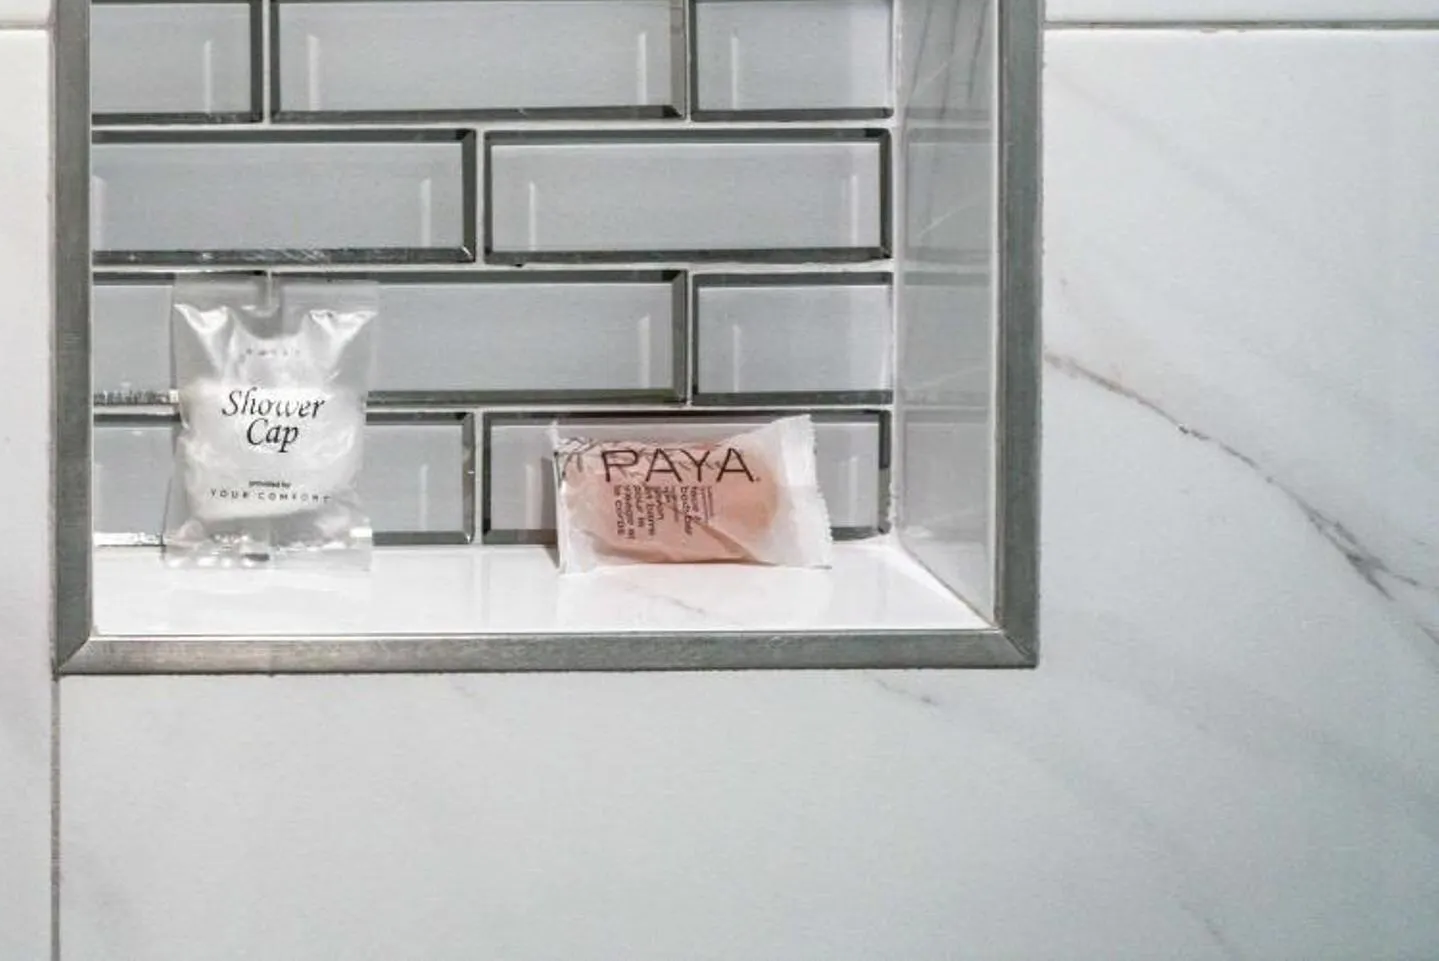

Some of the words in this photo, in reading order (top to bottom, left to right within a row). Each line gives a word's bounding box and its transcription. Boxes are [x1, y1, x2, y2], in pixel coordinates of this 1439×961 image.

[221, 386, 326, 420] Shower
[246, 417, 300, 453] Cap
[210, 488, 249, 498] YOUR
